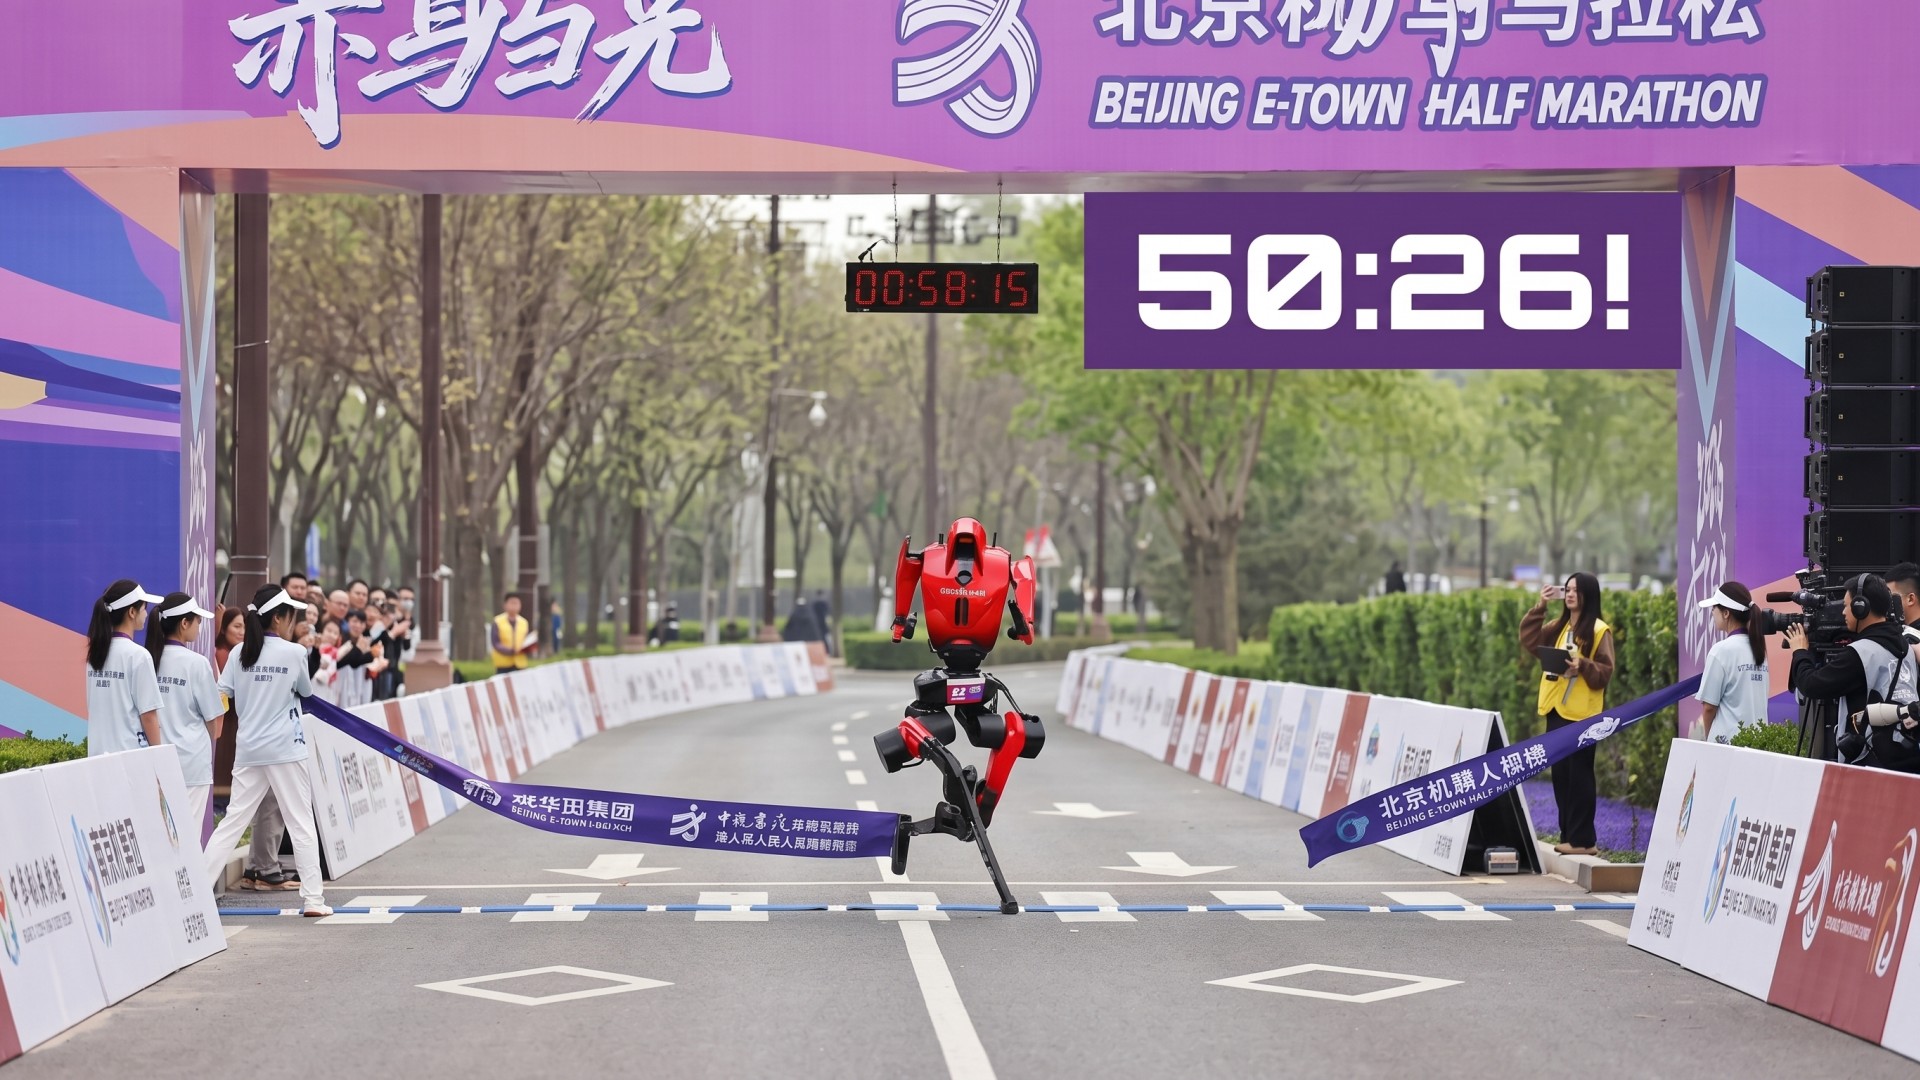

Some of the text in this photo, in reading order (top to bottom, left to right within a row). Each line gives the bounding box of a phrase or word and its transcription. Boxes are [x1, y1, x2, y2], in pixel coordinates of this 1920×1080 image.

[1094, 80, 1762, 125] BEIJING E-TOWN HALF MARATHON
[856, 270, 1028, 306] 00:58:15
[549, 816, 587, 828] E-TOWN
[1386, 812, 1426, 832] BEIJING
[1428, 798, 1467, 818] E-TOWN
[1469, 788, 1494, 804] HALF
